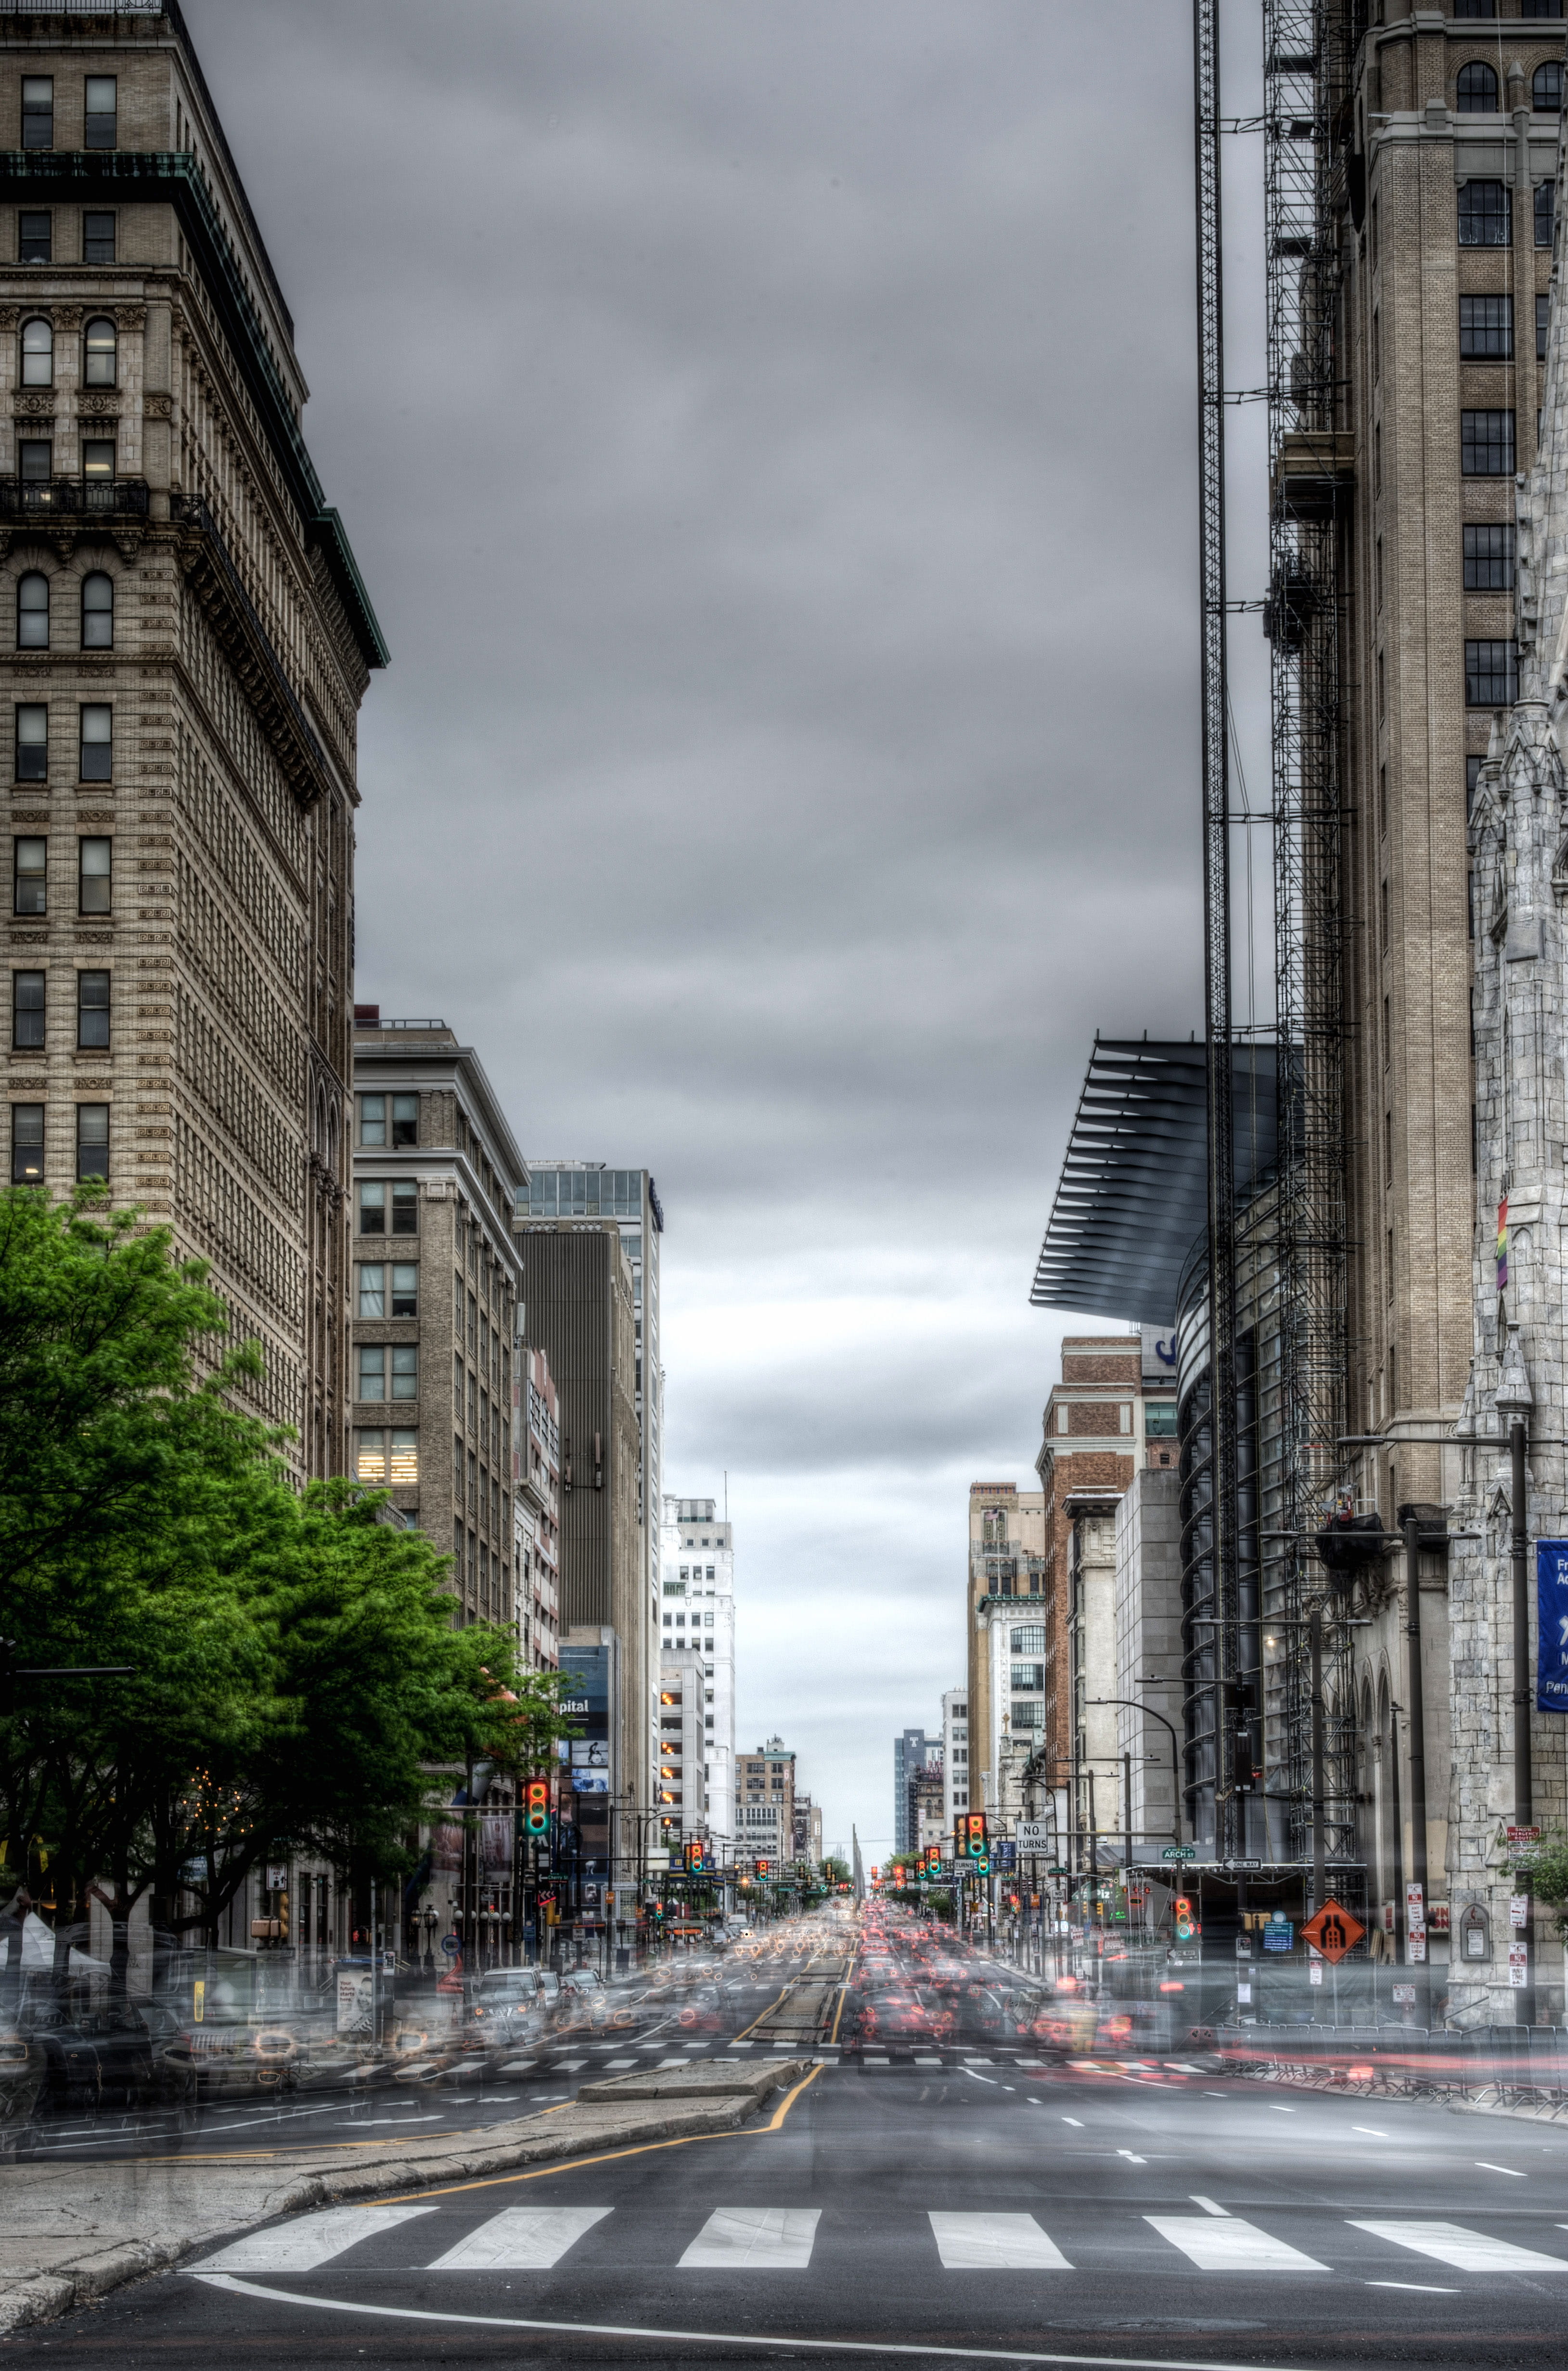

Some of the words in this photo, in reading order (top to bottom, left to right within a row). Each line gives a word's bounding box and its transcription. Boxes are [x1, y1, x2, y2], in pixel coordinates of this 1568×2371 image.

[559, 1699, 589, 1715] pital
[910, 1736, 919, 1748] T
[1024, 1826, 1039, 1836] NO
[1018, 1840, 1047, 1849] TURNS
